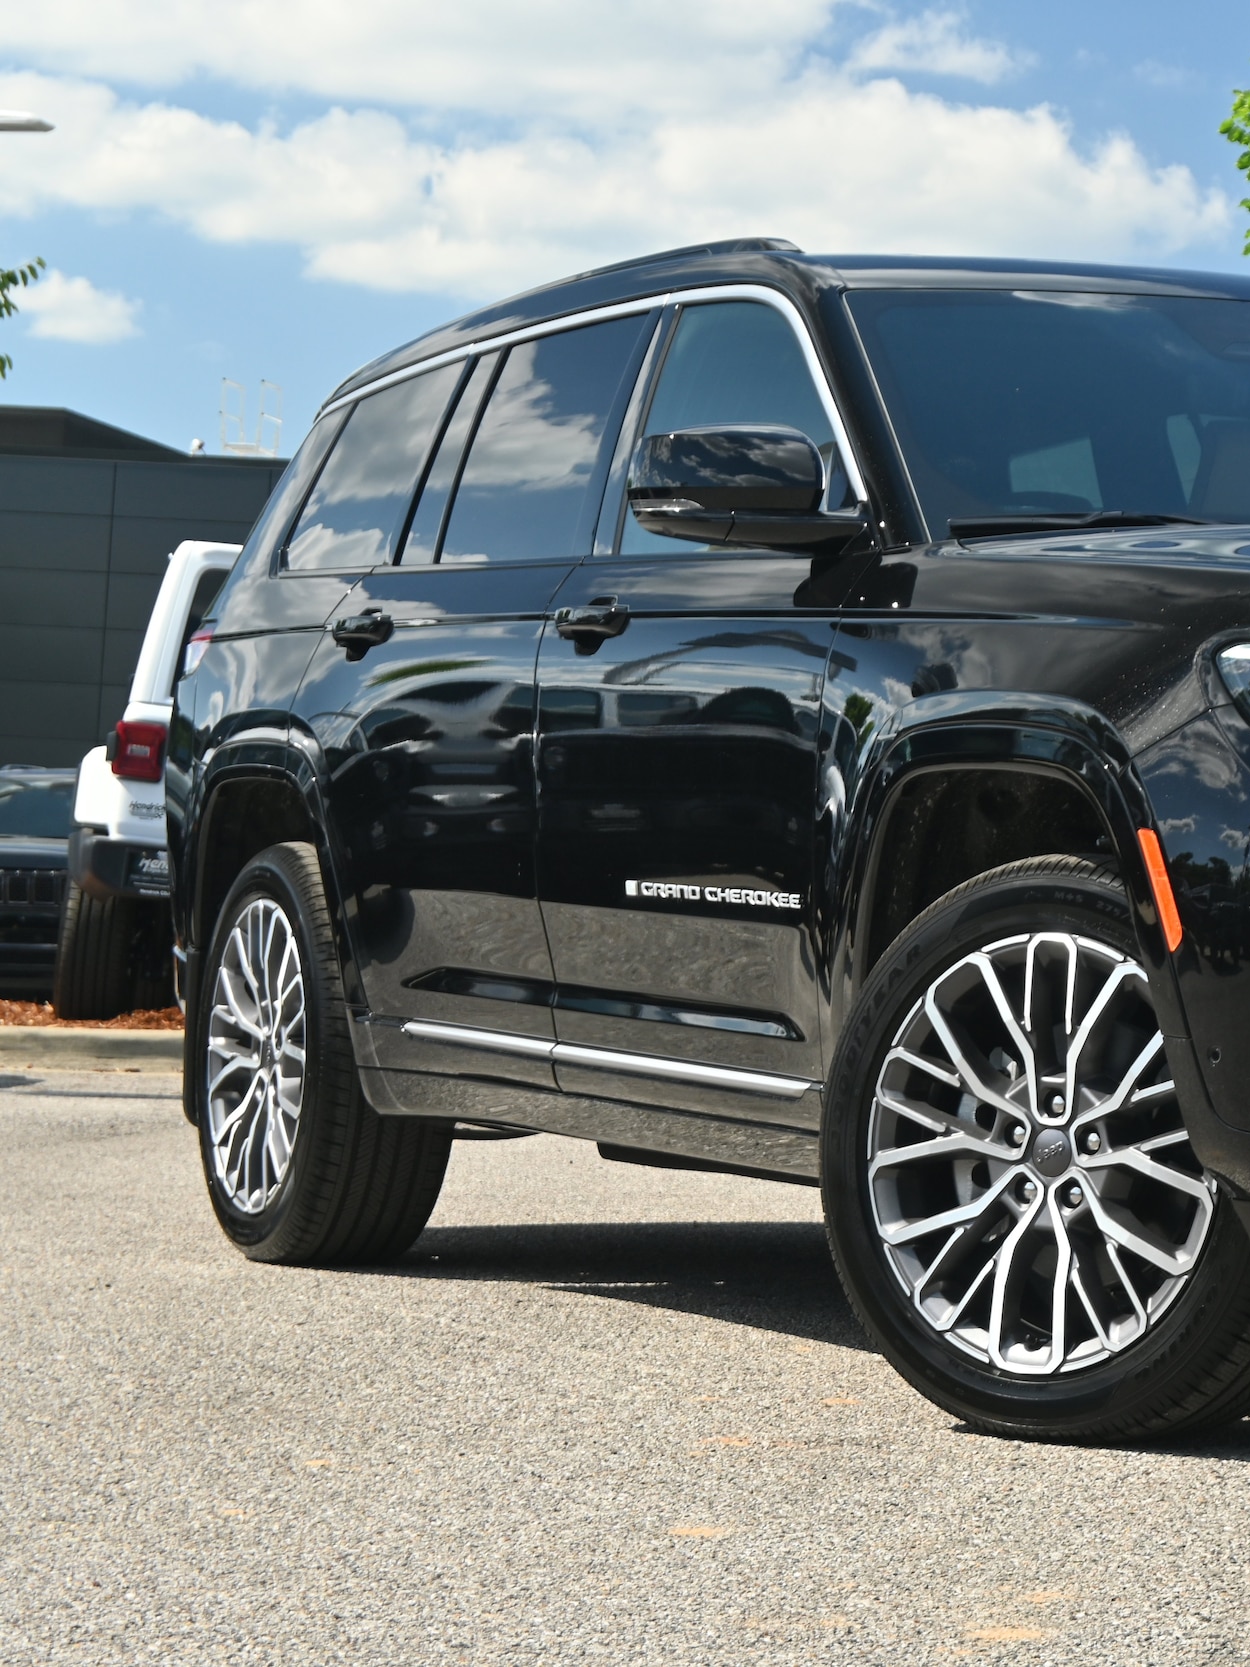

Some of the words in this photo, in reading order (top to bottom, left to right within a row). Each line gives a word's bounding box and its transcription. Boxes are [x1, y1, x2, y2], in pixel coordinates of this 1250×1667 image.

[641, 881, 701, 900] GRAND
[704, 886, 802, 909] CHEROKEE
[1036, 1140, 1065, 1163] Jeep
